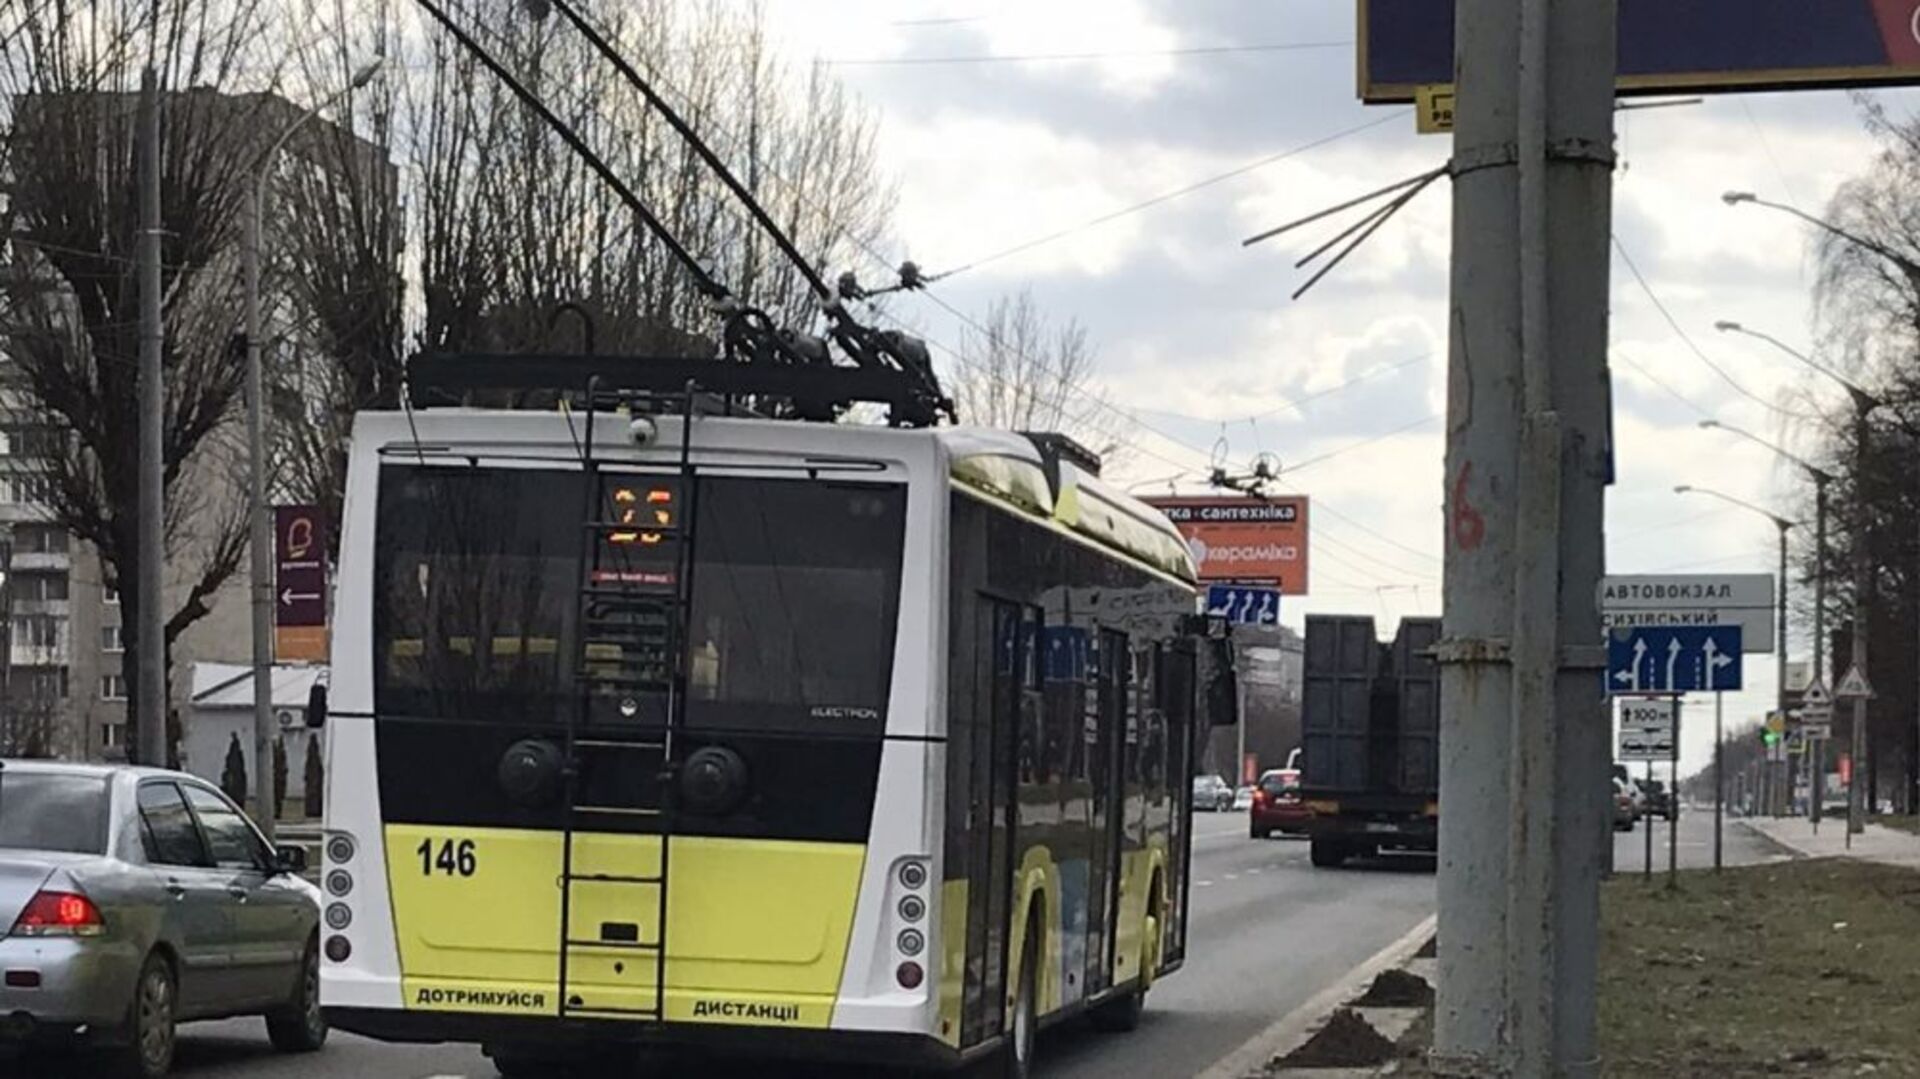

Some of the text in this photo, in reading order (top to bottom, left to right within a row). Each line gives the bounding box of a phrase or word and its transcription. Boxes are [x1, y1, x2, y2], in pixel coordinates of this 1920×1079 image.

[1201, 504, 1295, 519] сантехніка
[1604, 584, 1732, 599] АВТОВОКЗАЛ
[811, 707, 878, 719] ELECTRON
[1633, 708, 1657, 721] 100
[417, 838, 476, 877] 146
[417, 988, 545, 1008] ДОТРИМУЙСЯ
[693, 1001, 799, 1021] ДИСТАНЦІЇ
